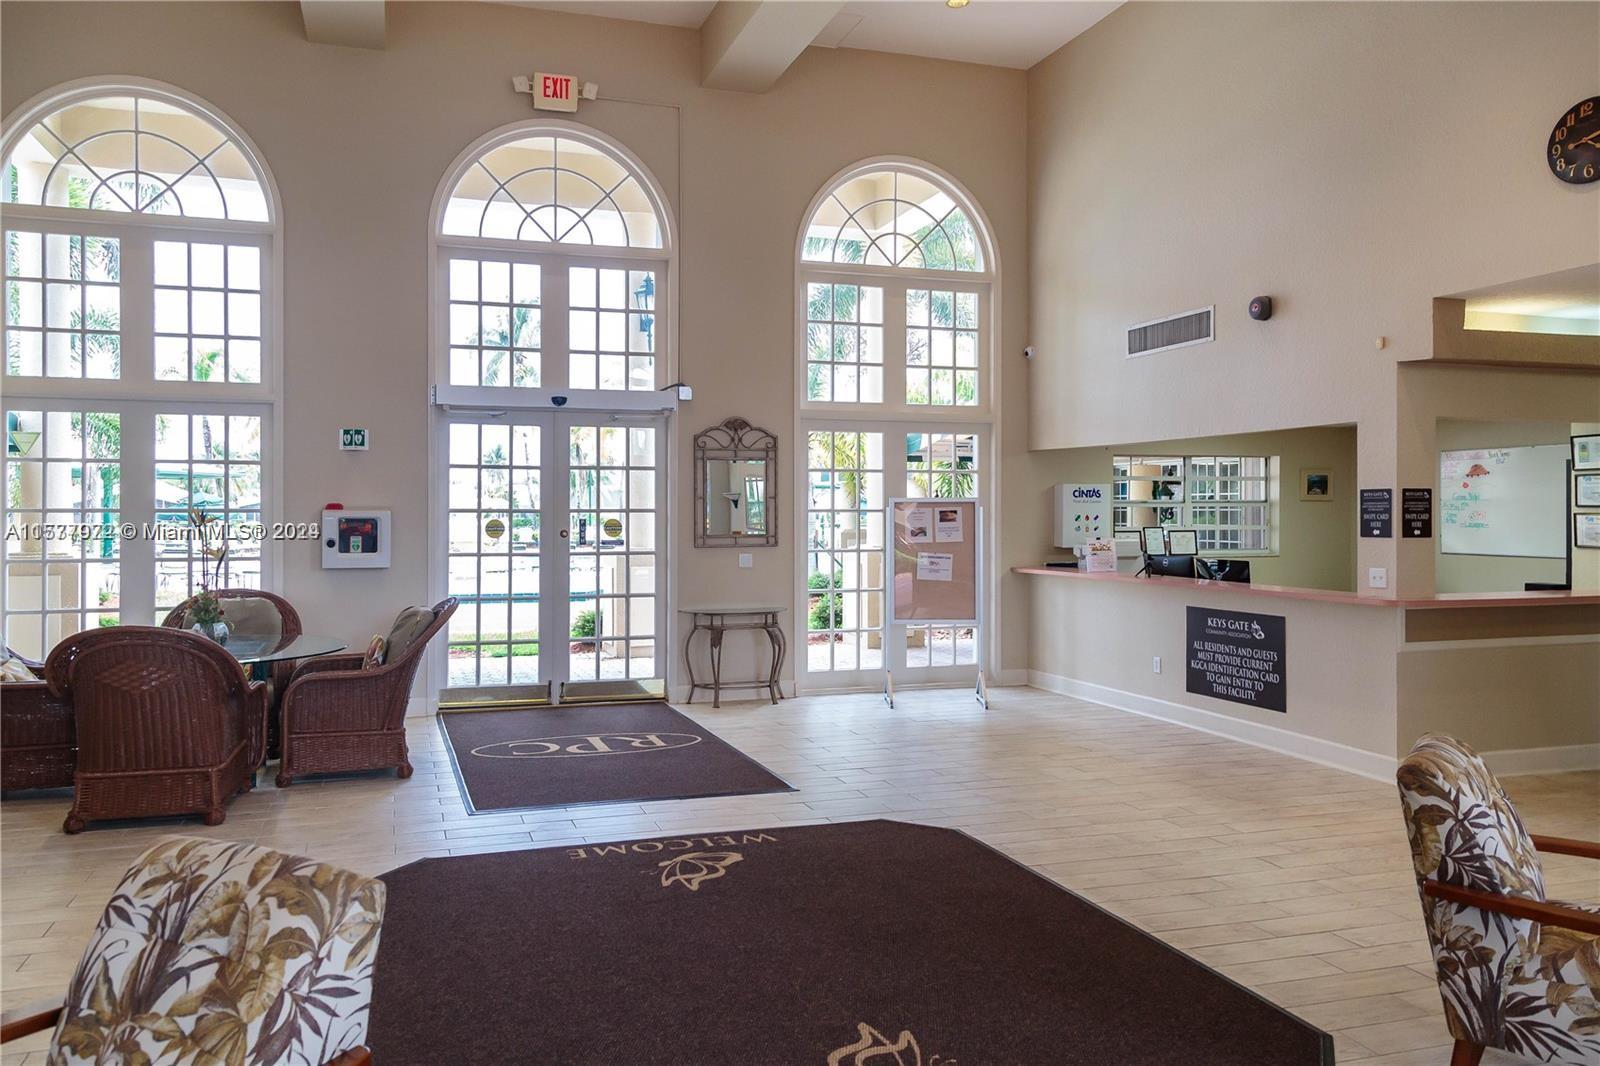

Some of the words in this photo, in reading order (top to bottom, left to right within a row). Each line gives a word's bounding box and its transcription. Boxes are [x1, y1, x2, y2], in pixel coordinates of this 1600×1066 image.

[543, 76, 571, 100] EXIT
[1580, 102, 1593, 118] 12
[1567, 112, 1575, 127] 11
[1555, 126, 1567, 141] 10
[1552, 144, 1561, 158] 9
[1556, 158, 1565, 171] 8
[1568, 163, 1577, 177] 7
[1583, 164, 1594, 178] 6
[1072, 486, 1102, 499] CINTAS
[1207, 617, 1226, 629] KEYS
[1228, 619, 1249, 631] GATE
[1193, 641, 1204, 650] ALL
[1204, 642, 1237, 655] RESIDENTS
[1237, 647, 1252, 657] AND
[1253, 649, 1278, 661] GUESTS
[1197, 651, 1215, 661] MUST
[1215, 653, 1241, 667] PROVIDE
[1242, 659, 1273, 671] CURRENT
[1191, 660, 1207, 670] KGCA
[1208, 662, 1259, 680] IDENTIFICATION
[1260, 672, 1280, 683] CARD
[1206, 672, 1215, 681] TO
[1215, 674, 1232, 684] GAIN
[1232, 677, 1252, 689] ENTRY
[1254, 681, 1264, 691] TO
[1213, 683, 1227, 694] THIS
[508, 734, 668, 756] RPC
[567, 832, 778, 860] WELCOME
